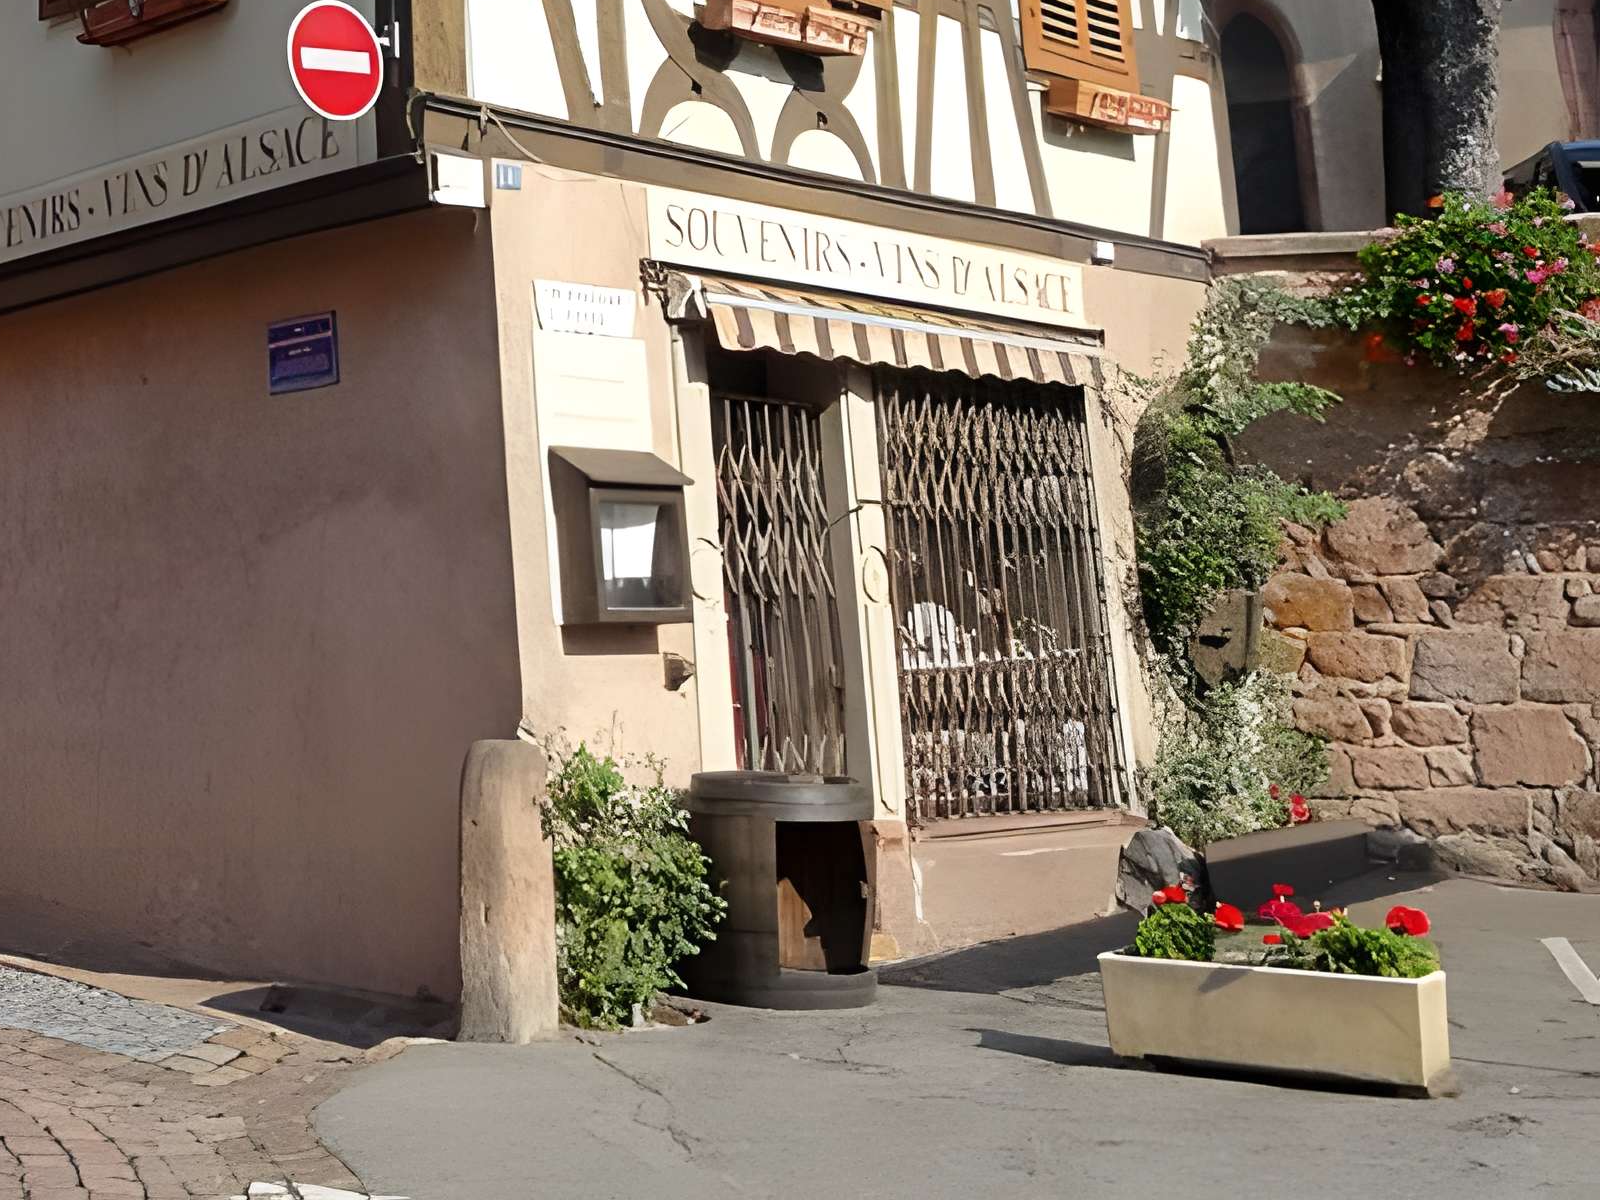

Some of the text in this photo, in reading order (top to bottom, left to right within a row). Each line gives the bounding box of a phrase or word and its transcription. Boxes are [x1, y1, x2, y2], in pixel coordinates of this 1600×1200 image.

[103, 160, 169, 218] VINS
[665, 204, 853, 275] SOUVENIRS
[873, 241, 941, 290] VINS
